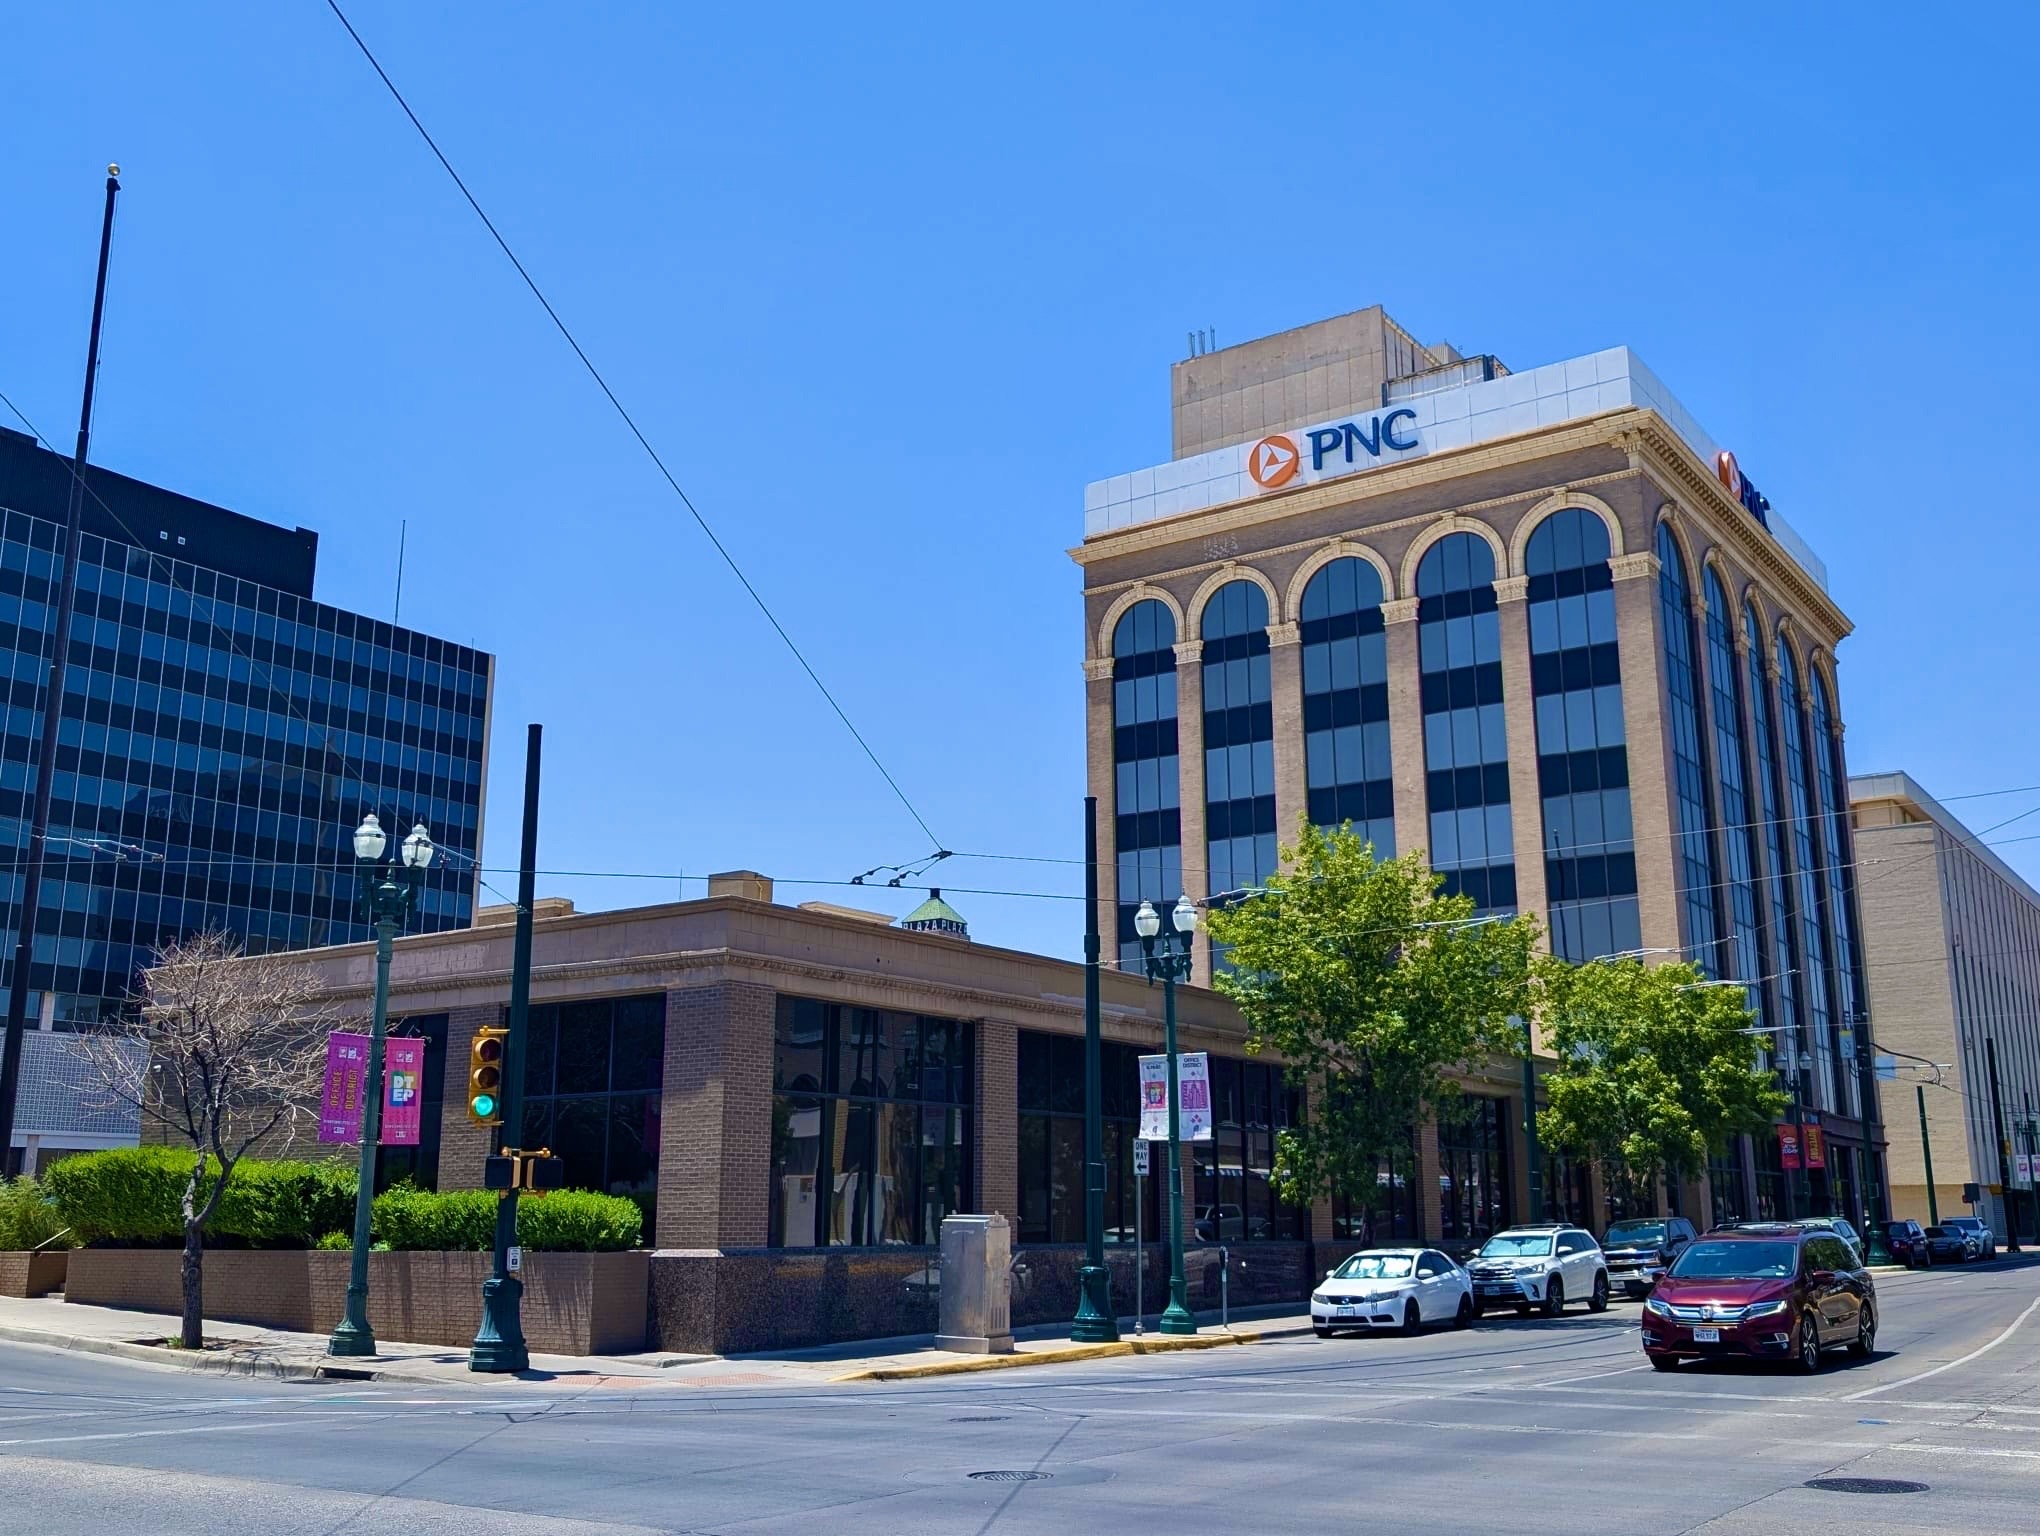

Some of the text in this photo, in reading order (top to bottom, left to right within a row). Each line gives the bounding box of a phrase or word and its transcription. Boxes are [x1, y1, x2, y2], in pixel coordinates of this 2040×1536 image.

[1306, 408, 1418, 470] PNC
[330, 1069, 343, 1106] OFFICE
[345, 1068, 359, 1110] DISTRICT
[393, 1075, 415, 1089] DT
[392, 1088, 414, 1102] EP
[1135, 1141, 1148, 1150] ONE
[1135, 1151, 1148, 1161] WAY
